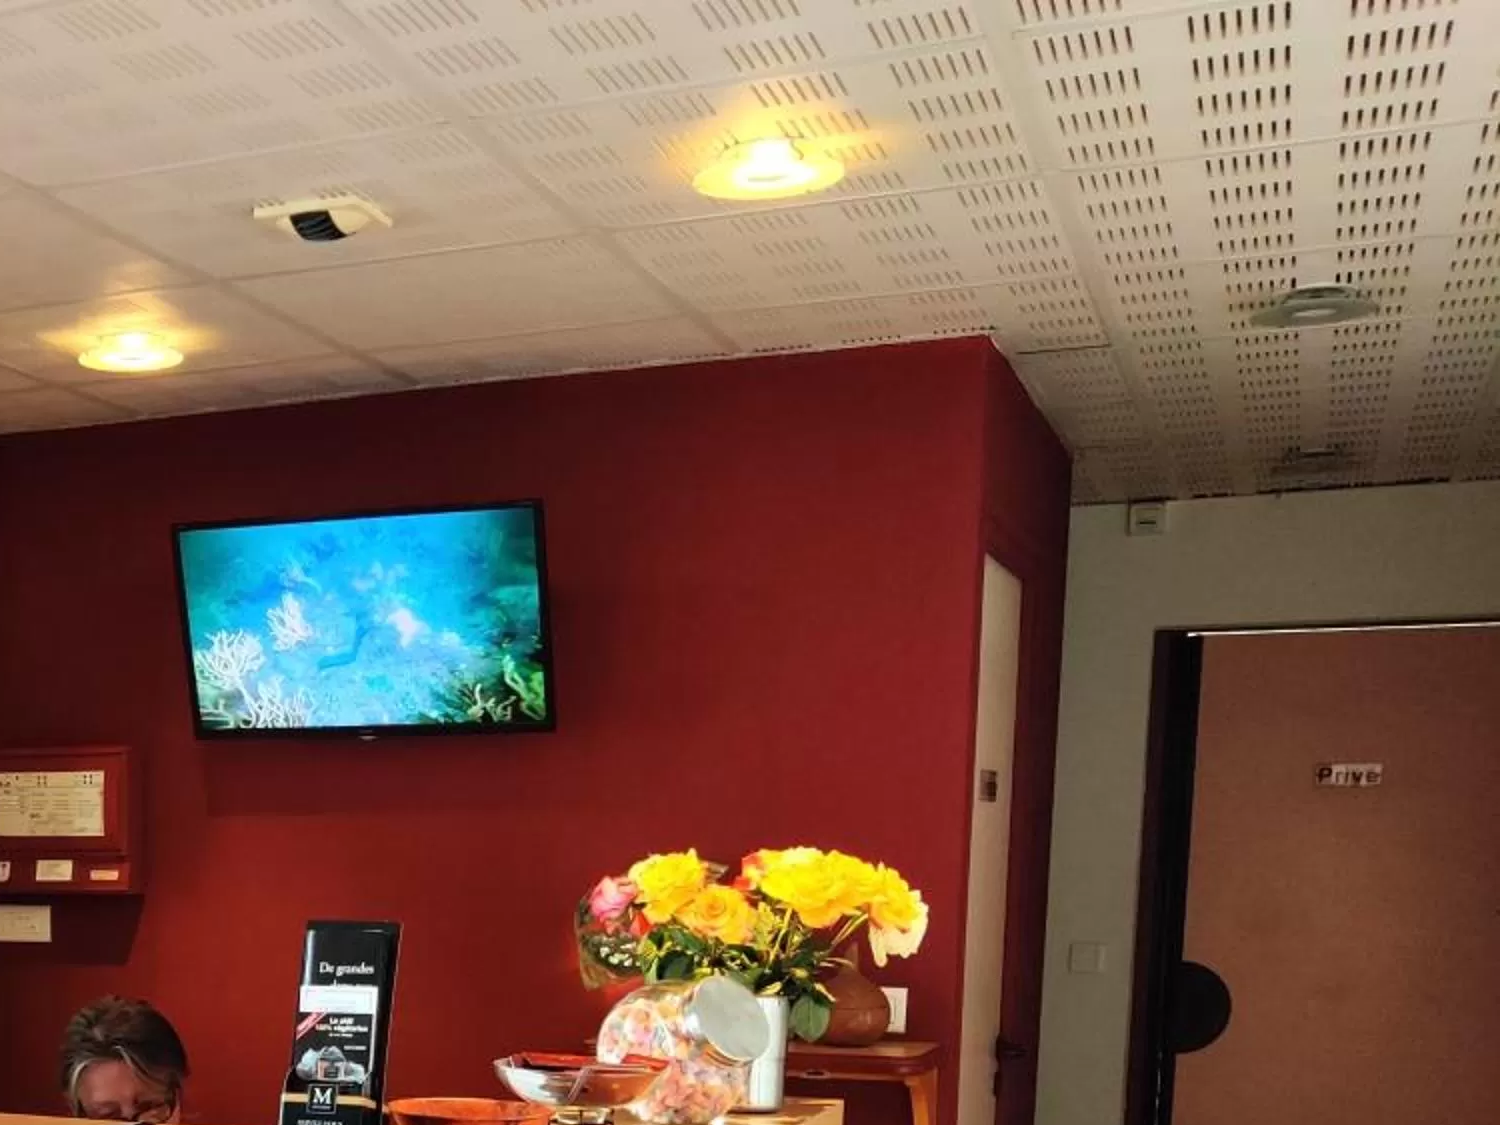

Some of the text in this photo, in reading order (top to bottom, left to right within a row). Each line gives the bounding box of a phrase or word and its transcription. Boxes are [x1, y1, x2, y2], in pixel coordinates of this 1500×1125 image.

[319, 961, 375, 977] De grandes
[313, 1087, 333, 1105] M
